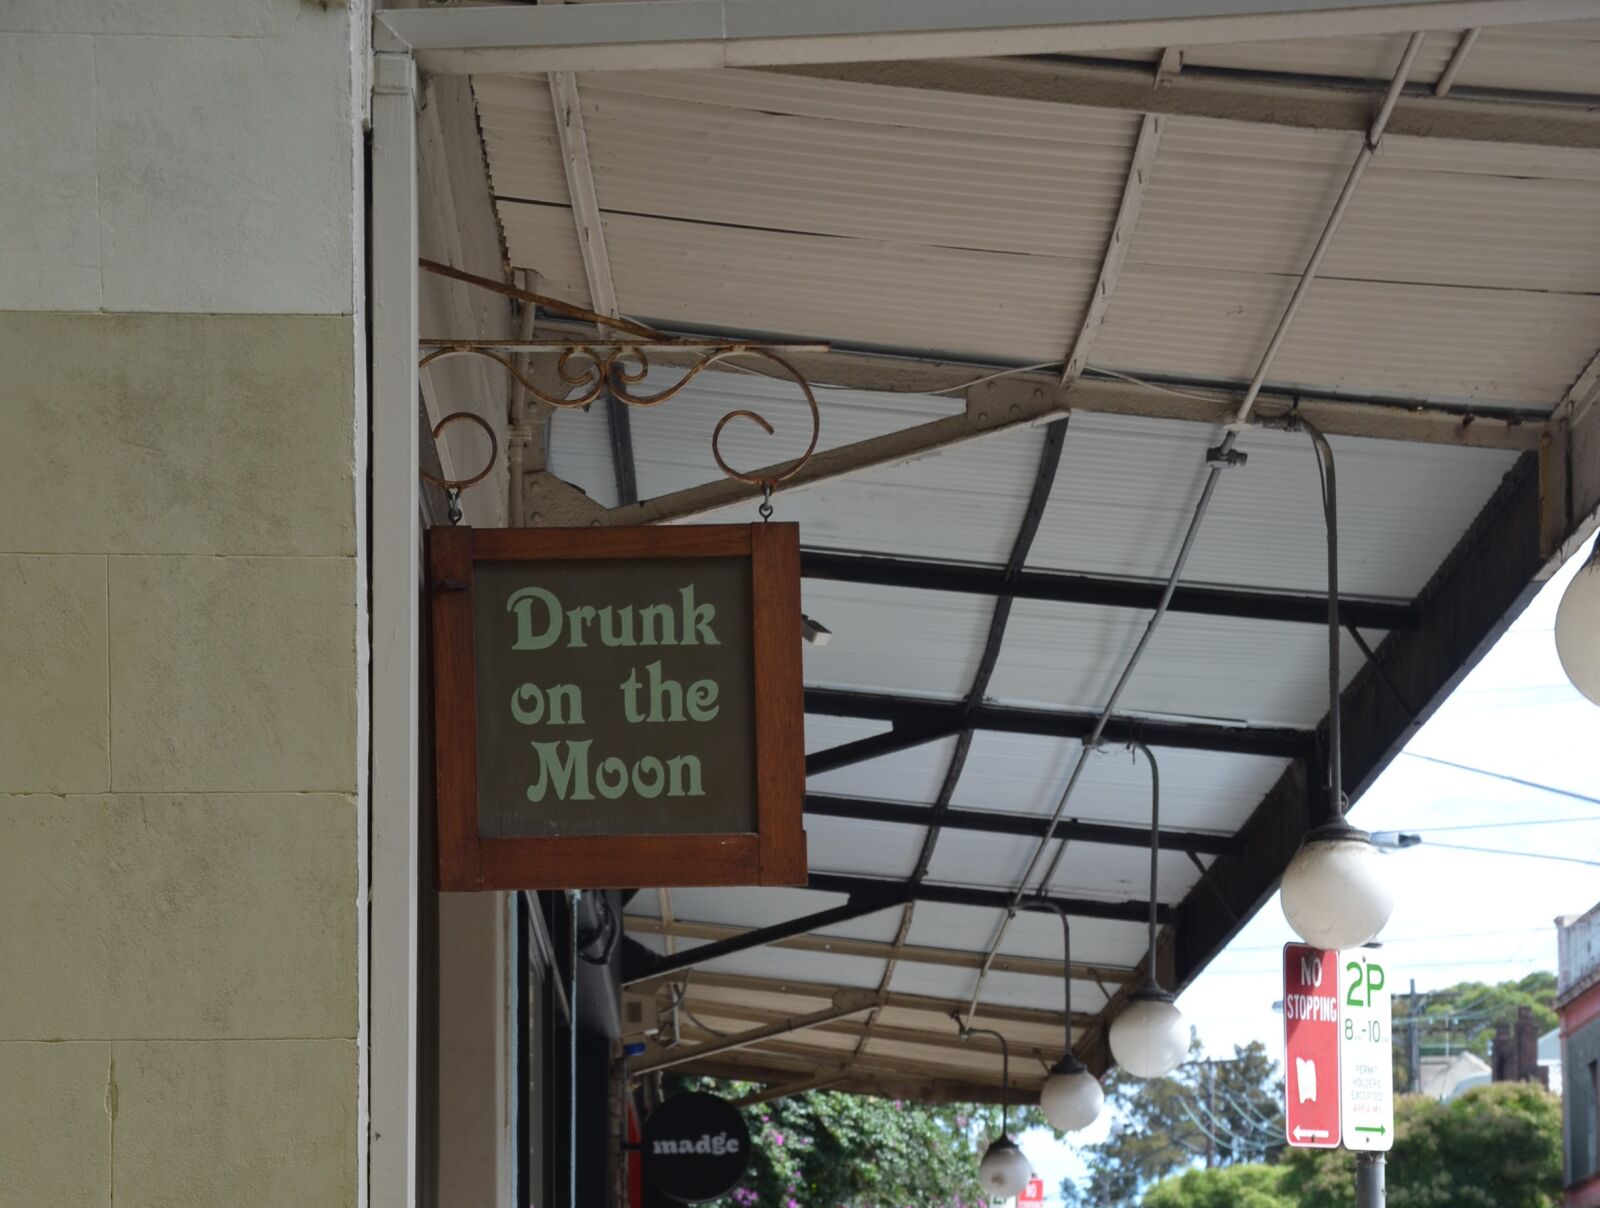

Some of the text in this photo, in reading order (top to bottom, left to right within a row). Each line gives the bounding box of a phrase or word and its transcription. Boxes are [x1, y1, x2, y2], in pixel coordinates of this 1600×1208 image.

[506, 584, 721, 650] Drunk
[510, 660, 720, 725] on the
[526, 739, 706, 802] Moon
[1300, 956, 1322, 987] NO
[1346, 961, 1385, 1007] 2P
[1287, 994, 1337, 1022] STOPPING
[653, 1132, 739, 1155] madge
[1026, 1182, 1037, 1198] NO
